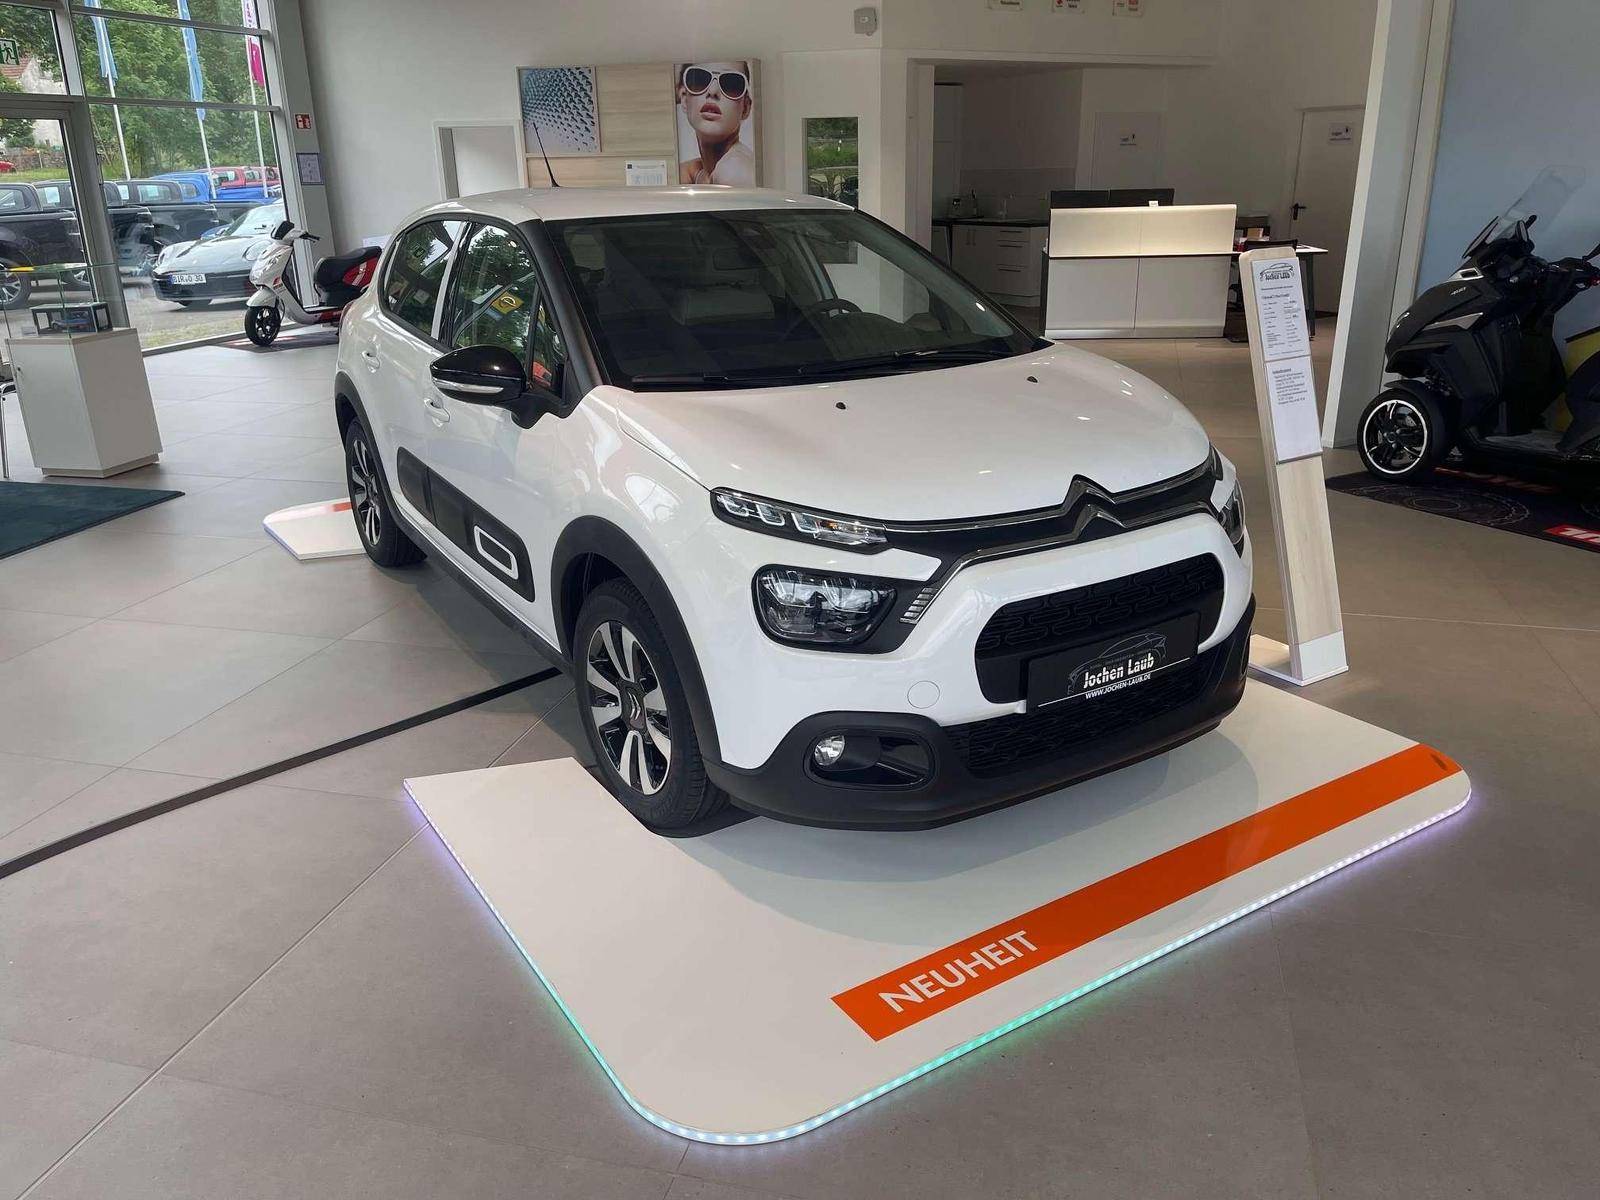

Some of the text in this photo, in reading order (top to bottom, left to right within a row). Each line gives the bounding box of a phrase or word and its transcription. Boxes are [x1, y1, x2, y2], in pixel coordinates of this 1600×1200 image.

[1083, 652, 1155, 689] Jochen Laub
[1085, 673, 1151, 700] WWW.JOCHEN-LAUB.DE
[878, 930, 1038, 1013] NEUHEIT
